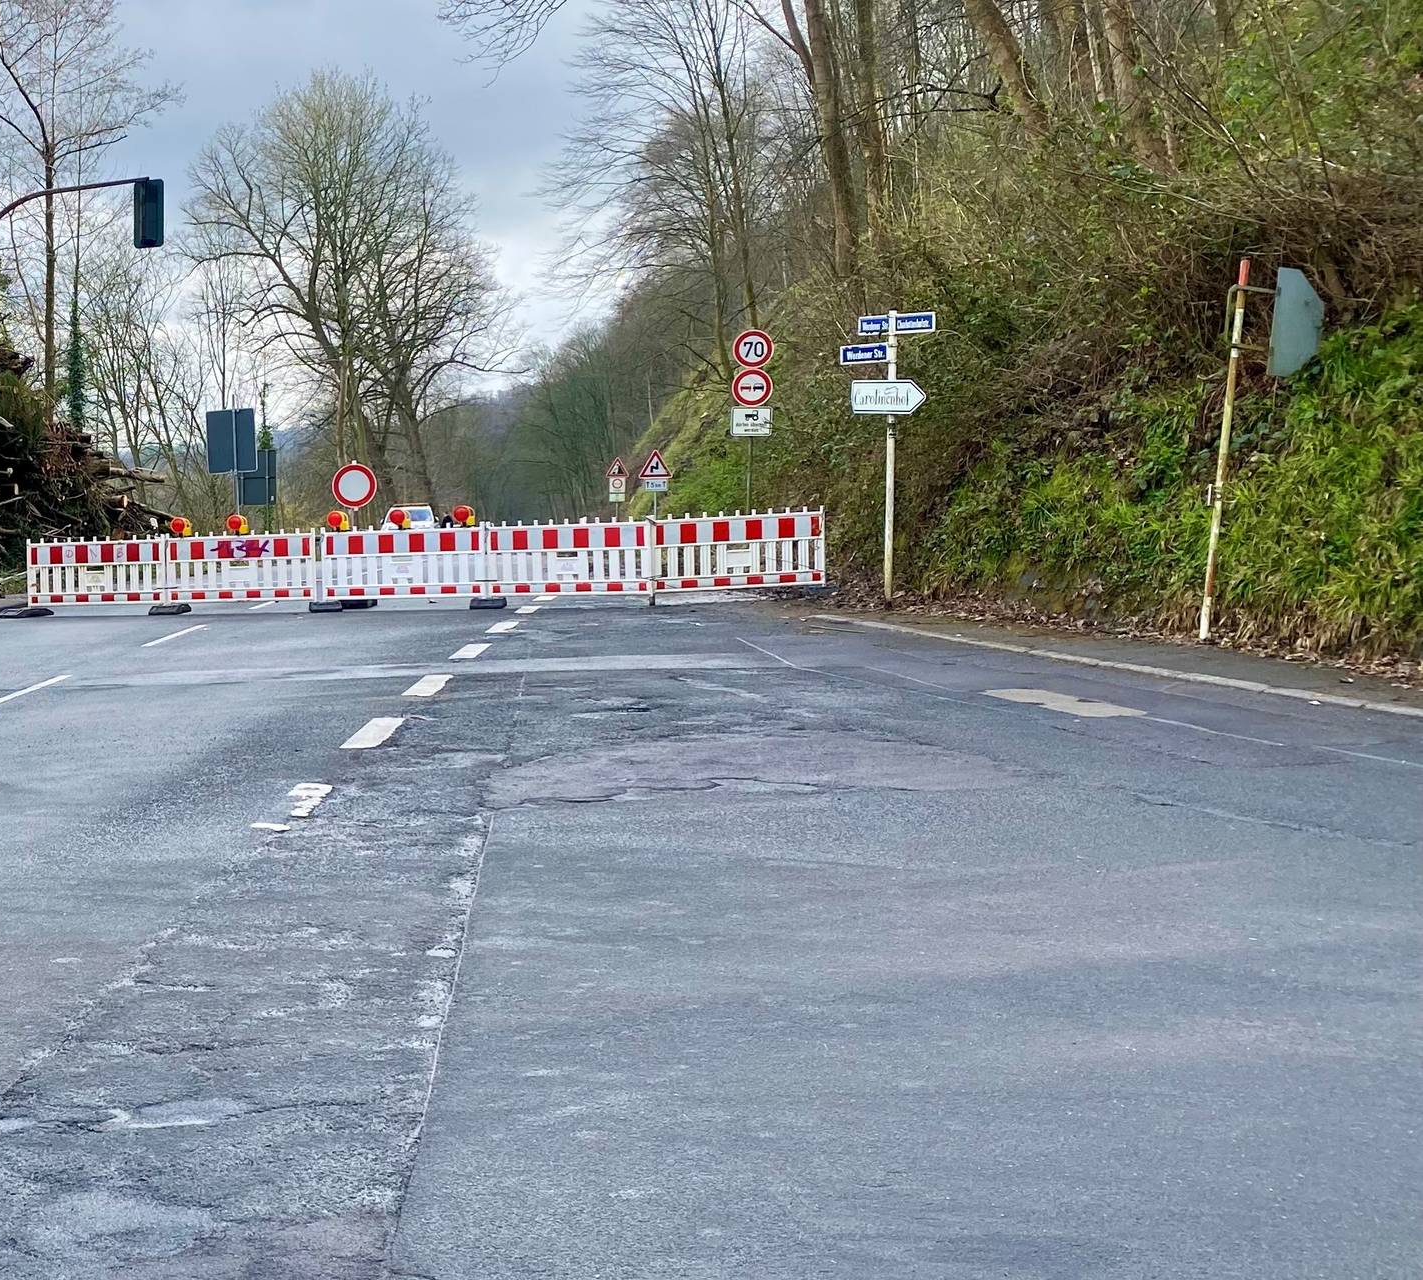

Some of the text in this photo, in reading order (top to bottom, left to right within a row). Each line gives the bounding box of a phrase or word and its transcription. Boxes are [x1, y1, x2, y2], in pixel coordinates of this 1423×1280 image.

[743, 341, 765, 359] 70
[846, 348, 886, 361] Werdener Str.
[854, 388, 912, 406] Carolinenhof
